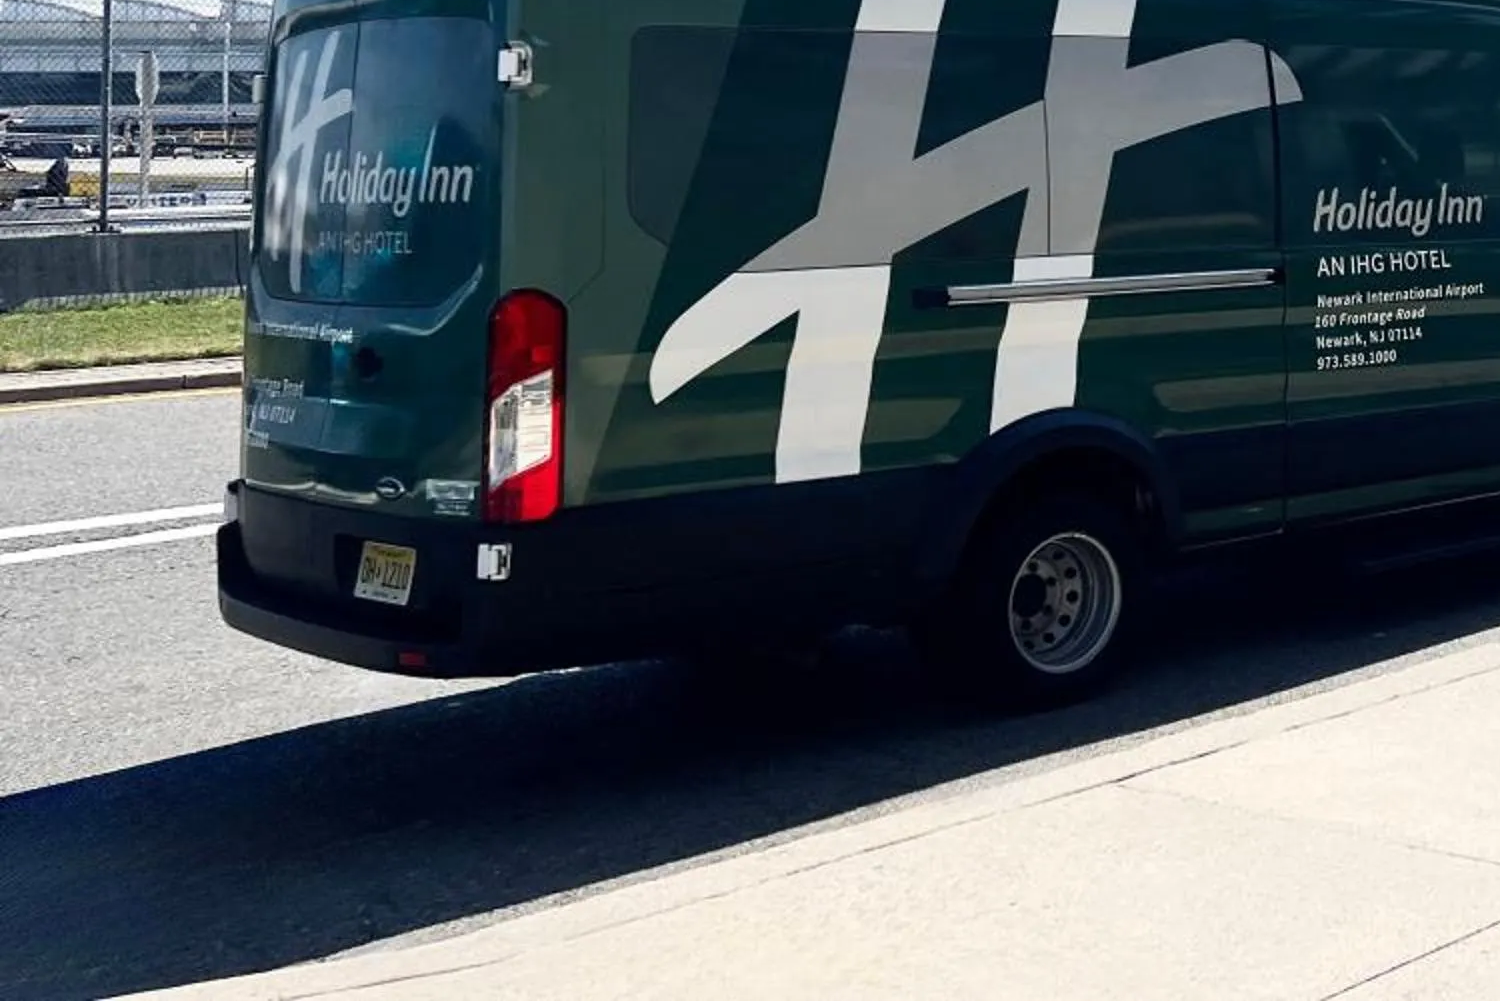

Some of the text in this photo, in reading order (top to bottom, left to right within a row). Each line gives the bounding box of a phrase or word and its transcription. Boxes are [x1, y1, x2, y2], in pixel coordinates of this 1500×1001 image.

[320, 123, 474, 218] Holiday Inn
[1313, 182, 1484, 237] Holiday Inn
[363, 231, 413, 254] HOTEL
[1317, 249, 1452, 277] AN IHG HOTEL
[1317, 282, 1484, 308] Newark International Airport
[1315, 305, 1426, 329] 160 Frontage Road
[1316, 326, 1423, 349] Newark, NJ 07114
